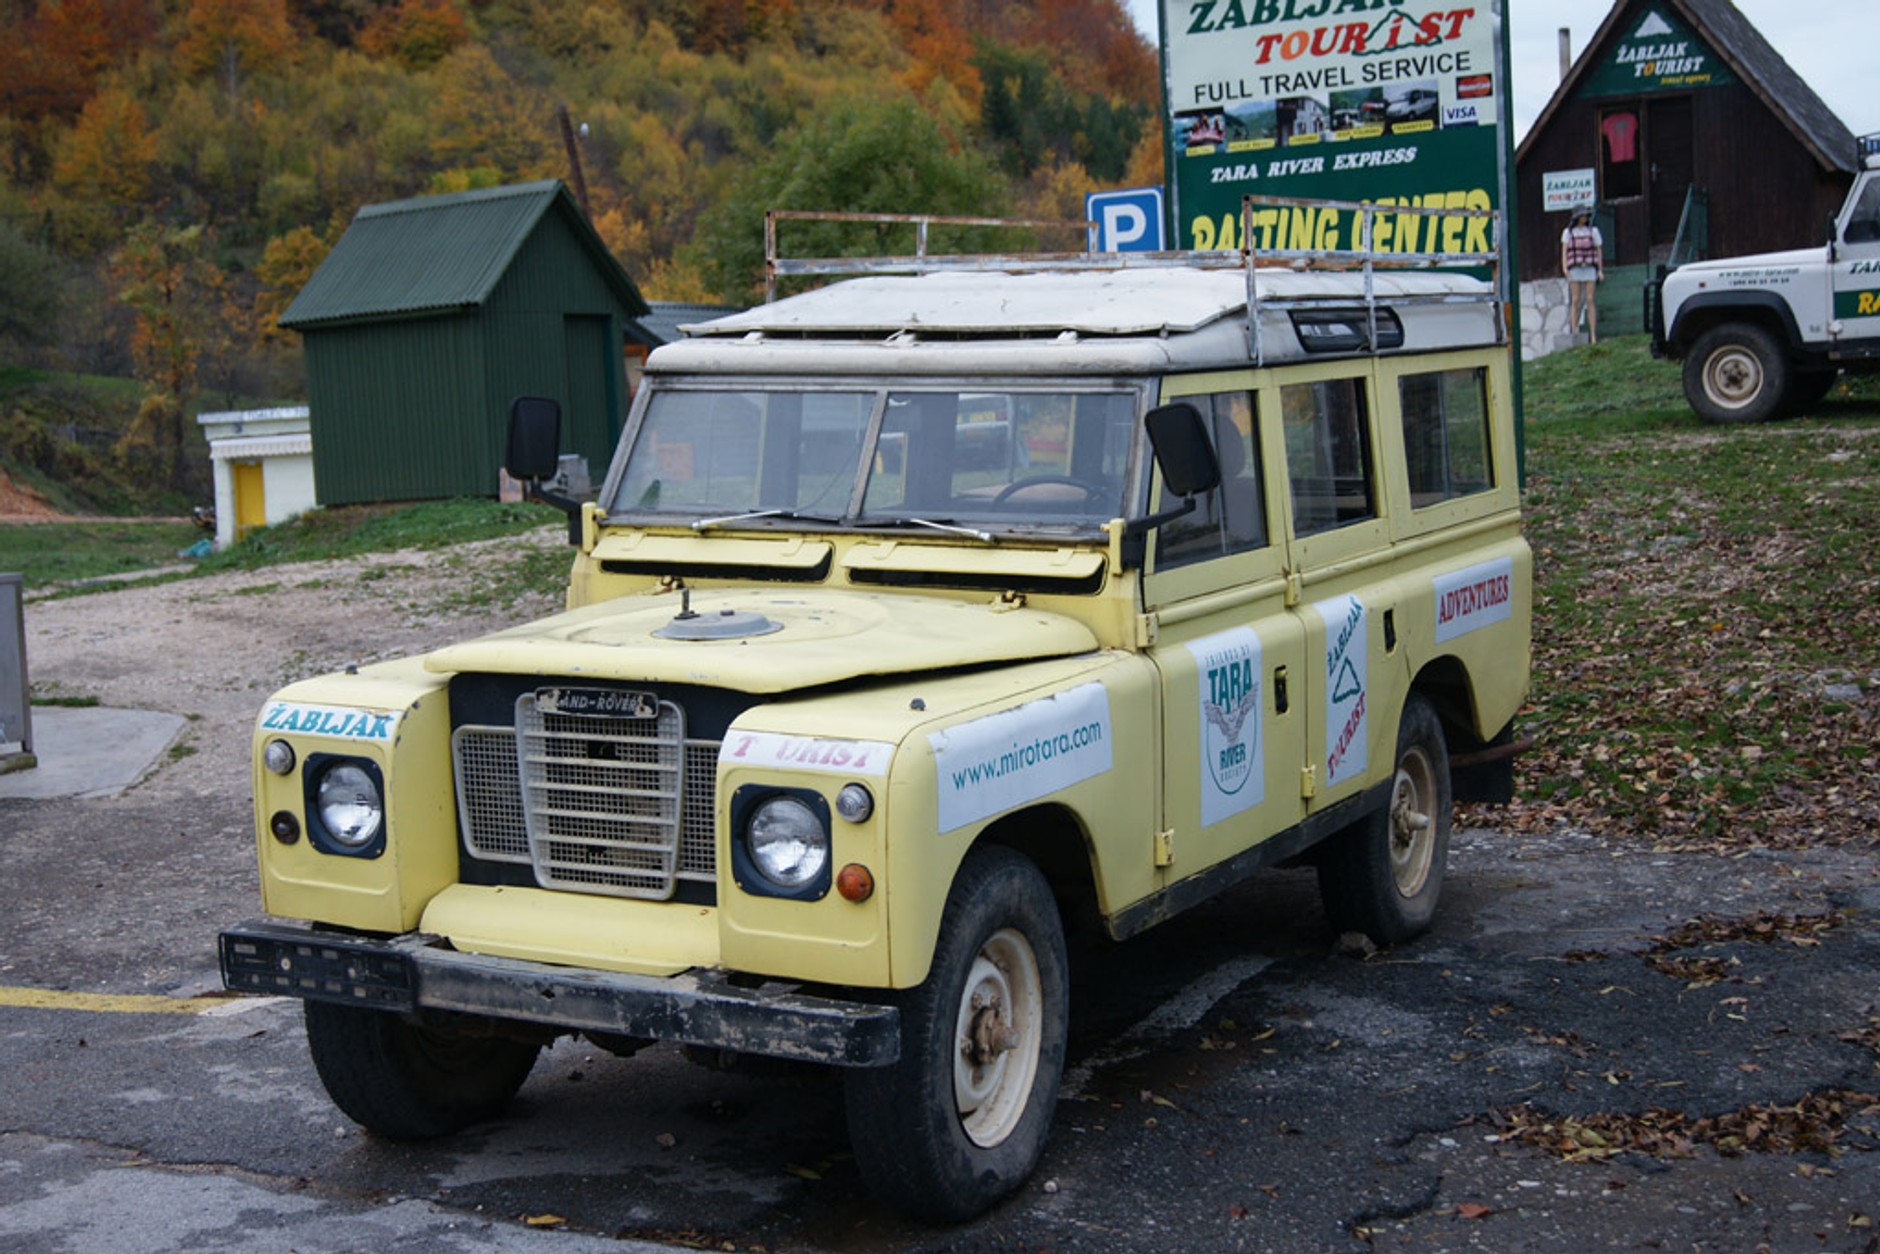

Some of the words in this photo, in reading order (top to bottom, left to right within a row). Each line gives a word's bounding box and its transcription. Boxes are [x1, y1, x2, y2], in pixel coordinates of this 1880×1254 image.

[1616, 42, 1688, 63] ŽABLJAK
[1634, 56, 1704, 77] TOURIST
[1194, 79, 1252, 104] FULL
[1260, 66, 1354, 95] TRAVEL
[1362, 51, 1471, 82] SERVICE
[1446, 105, 1477, 119] VISA
[1211, 165, 1258, 183] TARA
[1267, 157, 1324, 177] RIVER
[1333, 147, 1418, 171] EXPRESS
[1103, 203, 1147, 253] P
[1438, 574, 1509, 625] ADVENTURES
[1208, 658, 1253, 714] TARA
[262, 703, 394, 738] ŽABLJAK
[952, 721, 1102, 791] www.mirotara.com
[1219, 742, 1247, 770] RIVER
